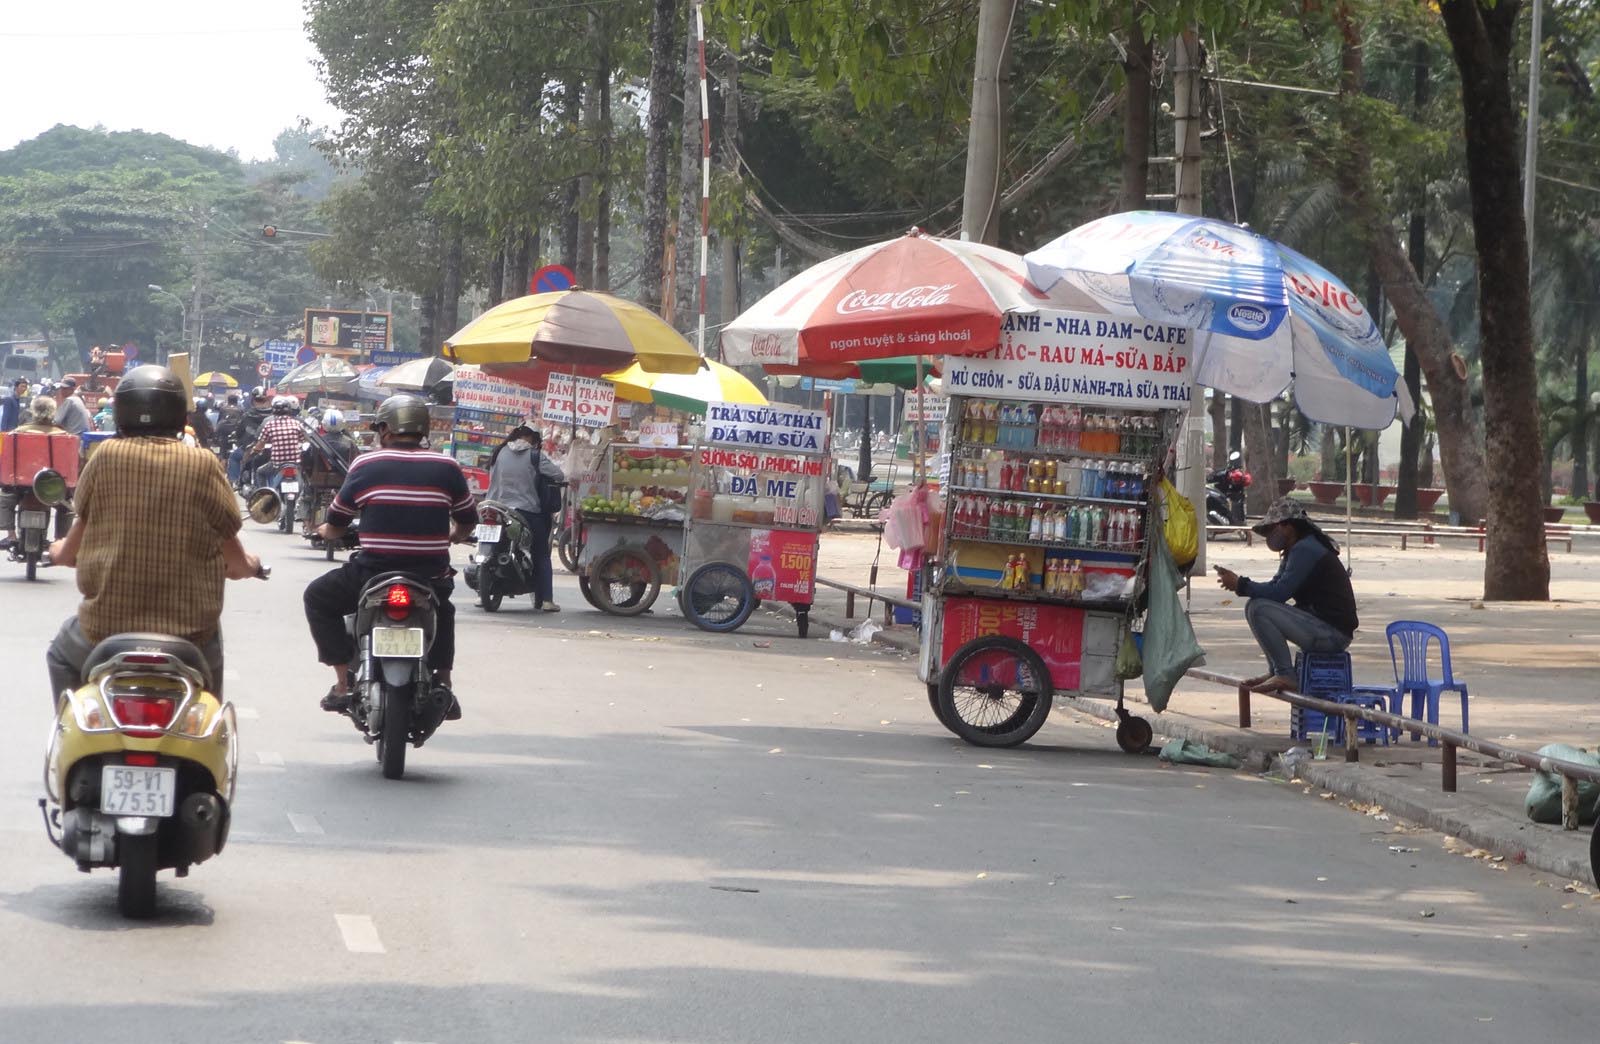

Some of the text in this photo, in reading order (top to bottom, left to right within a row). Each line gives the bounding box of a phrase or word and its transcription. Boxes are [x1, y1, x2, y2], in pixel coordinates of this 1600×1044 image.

[1056, 317, 1091, 337] NHA
[830, 338, 861, 351] ngon
[864, 334, 895, 349] tuyệt
[896, 333, 905, 343] &
[938, 328, 971, 341] khoái
[1153, 348, 1186, 373] BẮP
[951, 366, 968, 386] MỦ
[971, 369, 1004, 389] CHÔM
[1018, 373, 1041, 391] SỮA
[1044, 375, 1070, 396] ĐẬU
[1137, 378, 1159, 399] SỮA
[547, 398, 610, 417] TRỘN
[711, 404, 822, 430] TRÀ SỮA THÁI
[712, 425, 818, 449] ĐÁ ME SỮA
[731, 473, 797, 498] ĐÁ ME
[780, 553, 811, 570] 1.500
[114, 770, 160, 791] 59-V1
